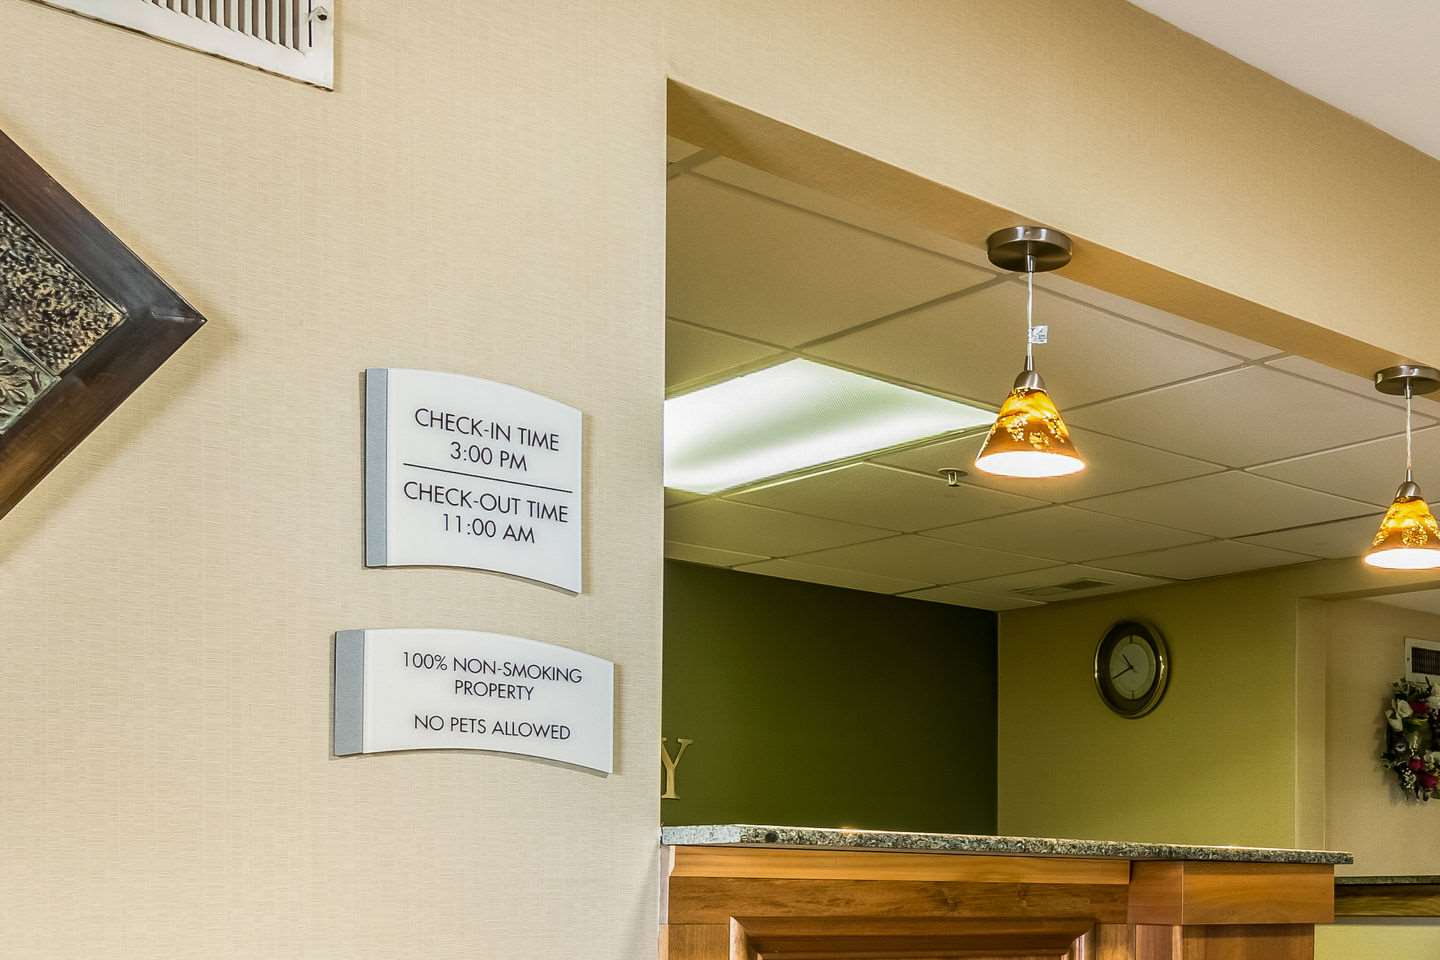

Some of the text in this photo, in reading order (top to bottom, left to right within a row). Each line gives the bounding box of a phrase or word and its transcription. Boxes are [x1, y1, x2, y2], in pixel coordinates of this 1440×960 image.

[414, 408, 559, 452] CHECK-IN TIME
[450, 441, 527, 472] 3:00 PM
[403, 481, 569, 523] CHECK-OUT TIME
[443, 513, 535, 544] 11:00 AM
[403, 651, 583, 685] 100% NON-SMOKING
[455, 679, 535, 701] PROPERTY
[414, 714, 571, 740] NO PETS ALLOWED
